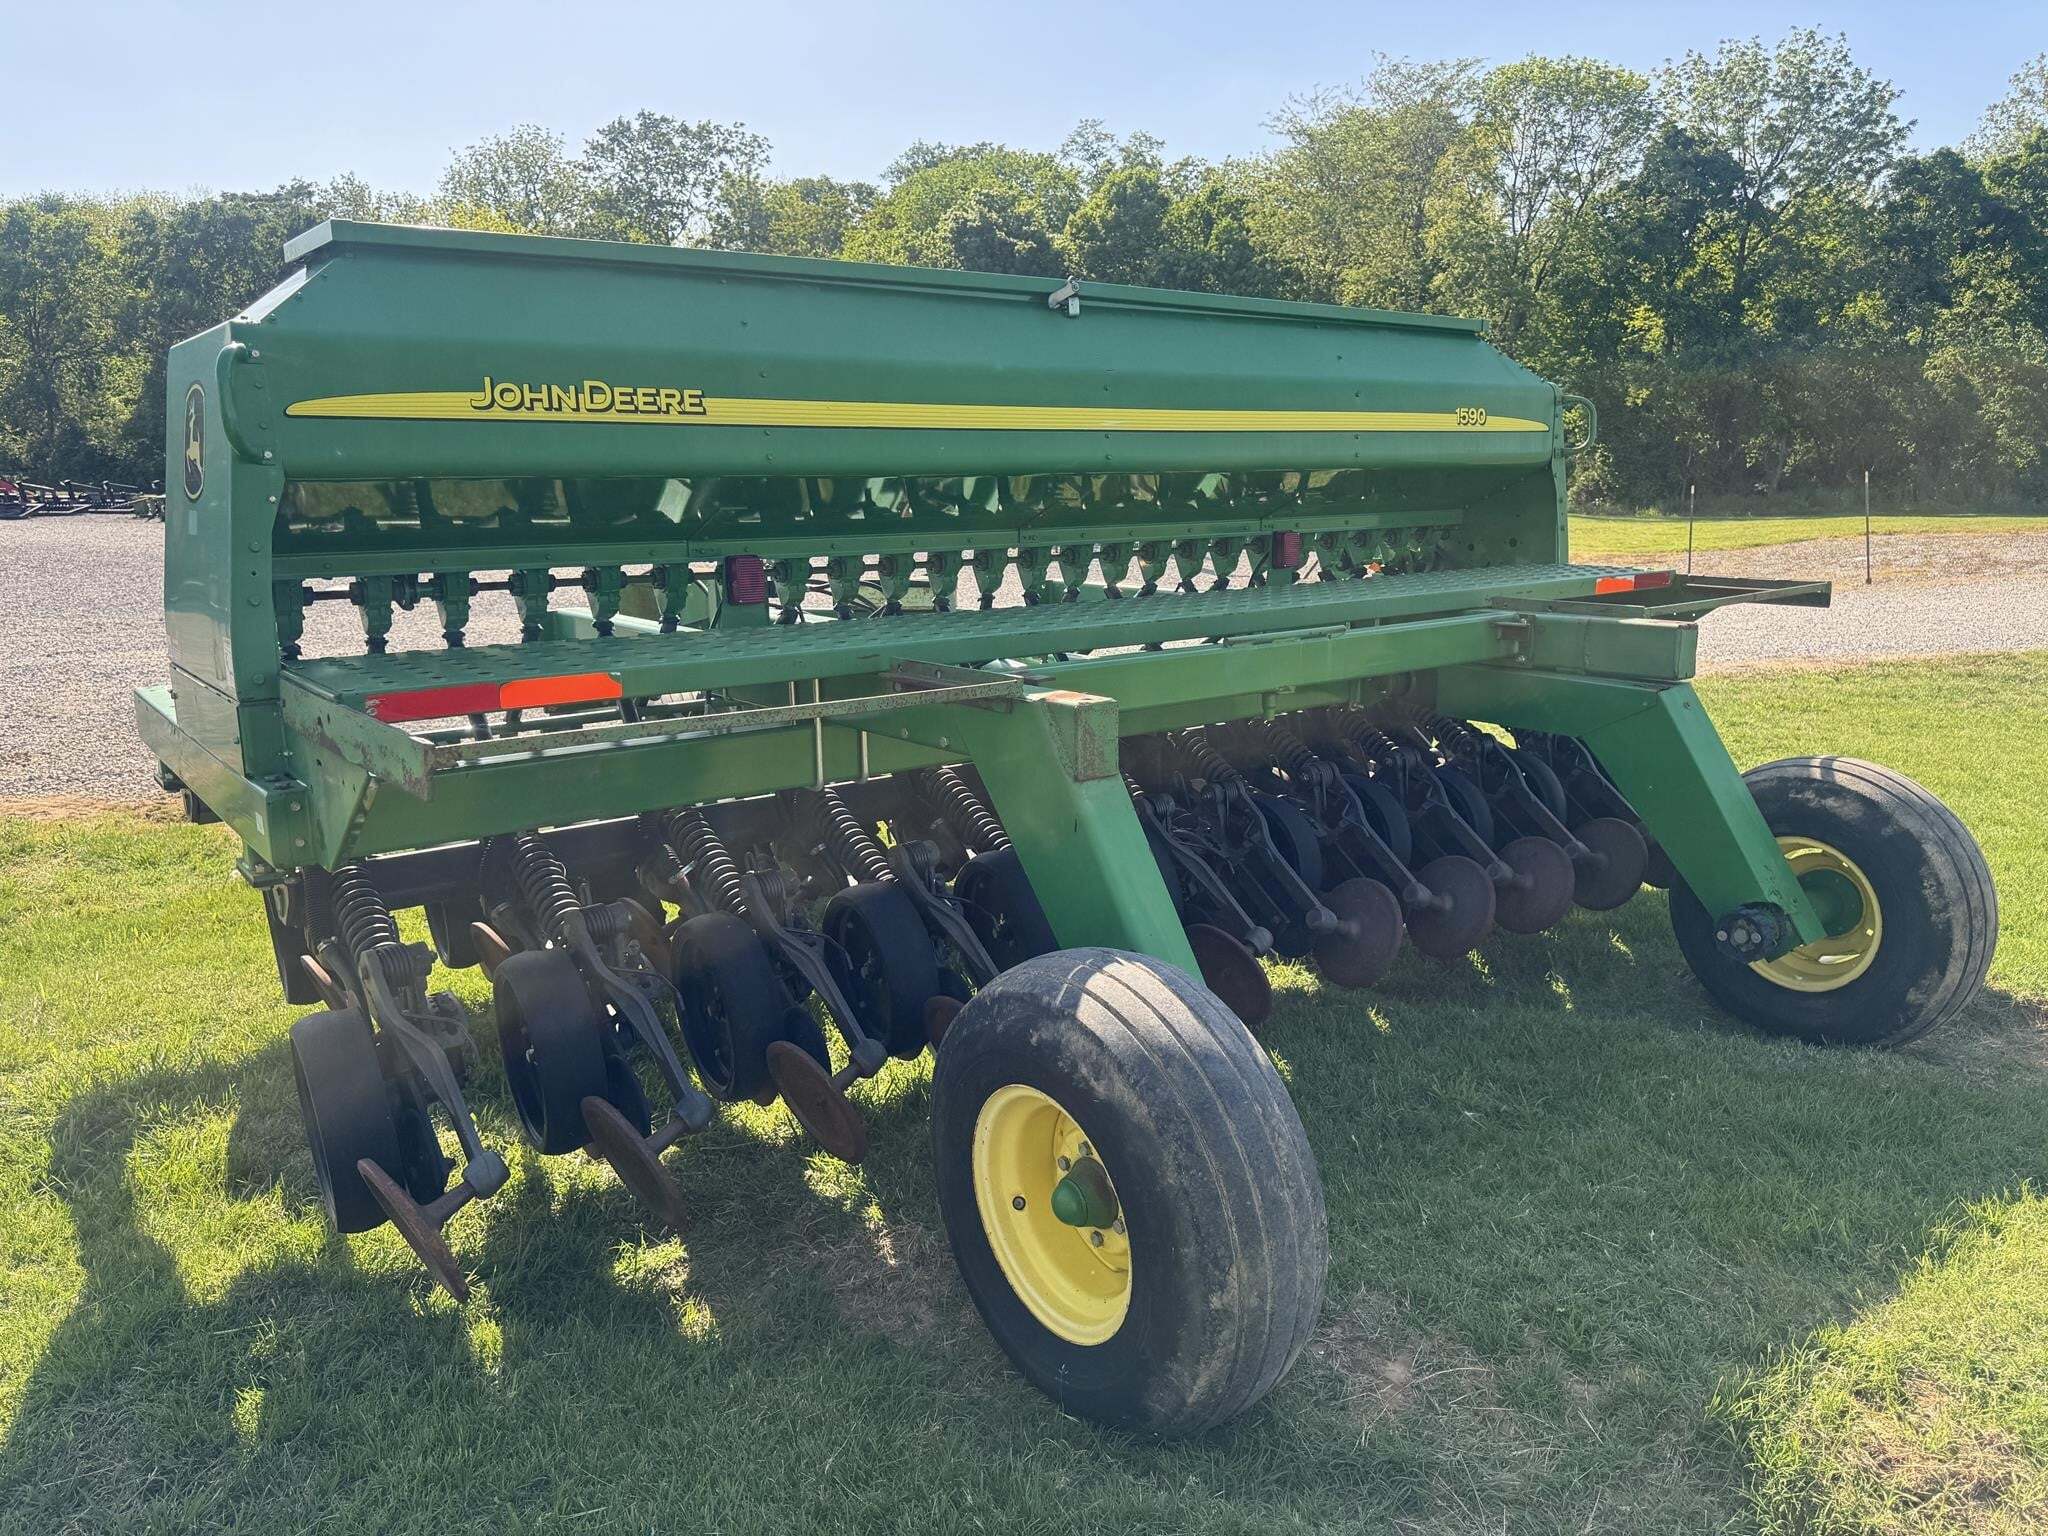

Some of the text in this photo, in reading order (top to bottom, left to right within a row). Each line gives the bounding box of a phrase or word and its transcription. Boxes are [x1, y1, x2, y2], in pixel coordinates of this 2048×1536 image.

[470, 376, 707, 416] JOHN DEERE
[1455, 407, 1487, 426] 1590
